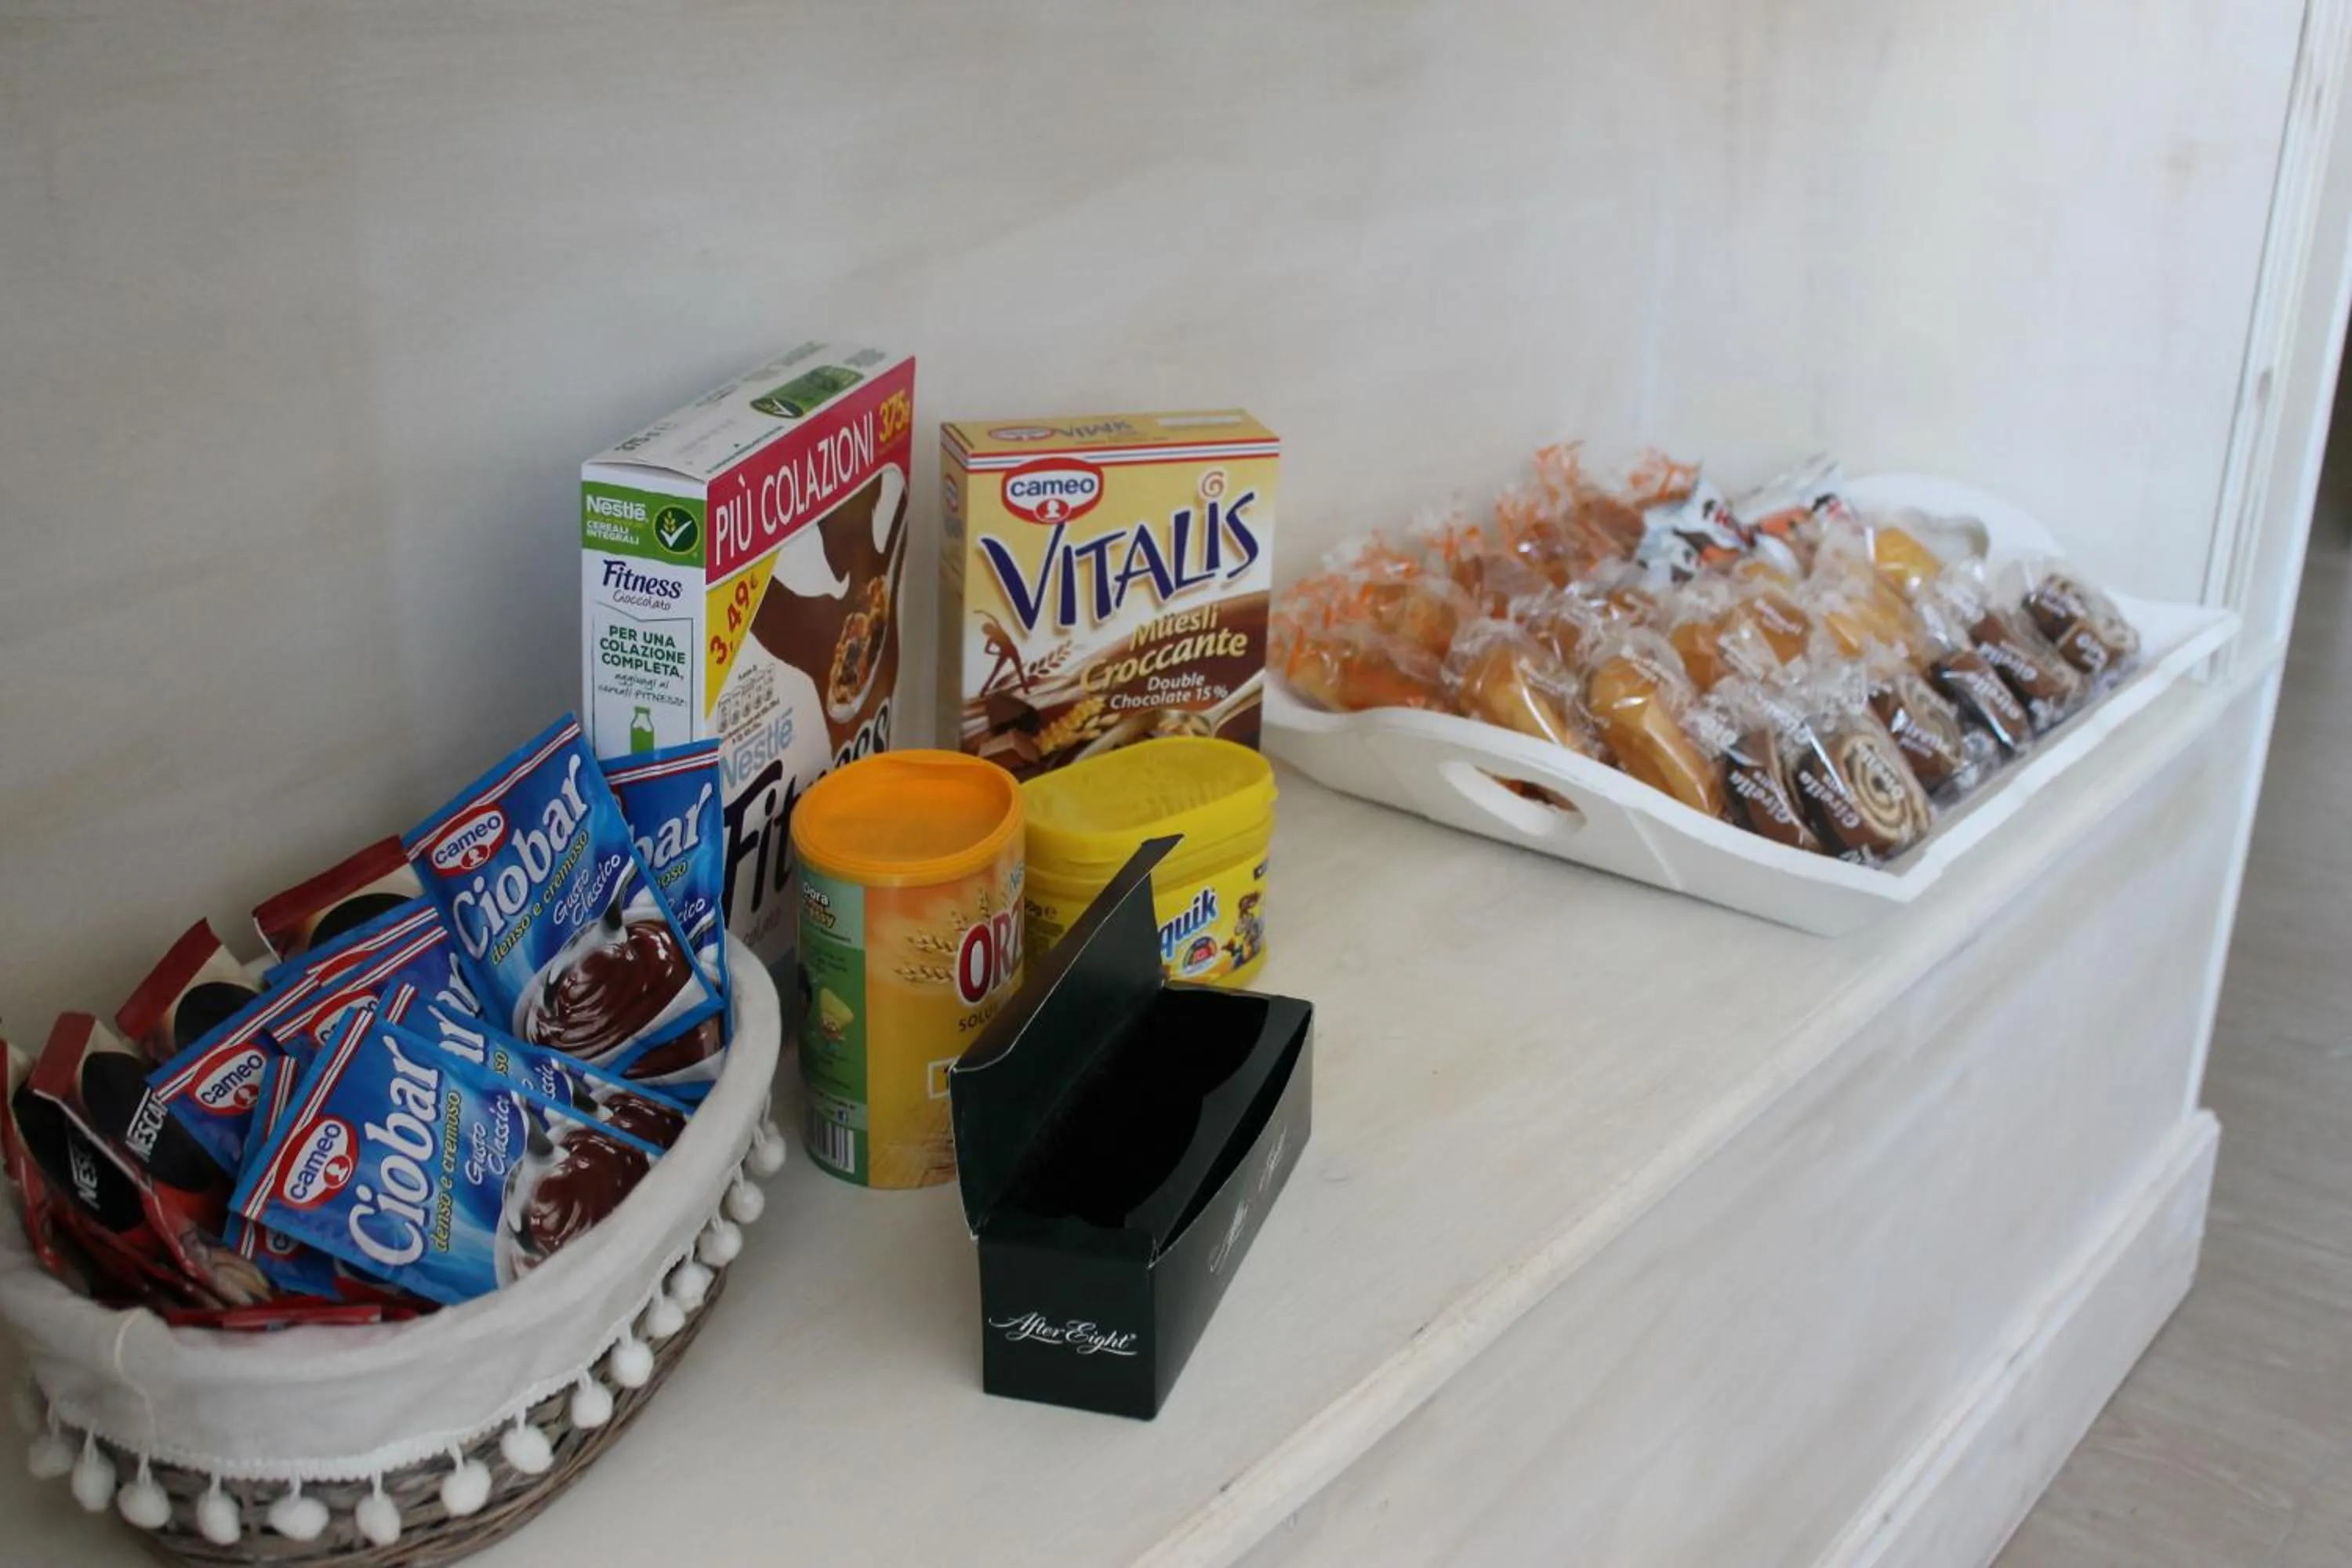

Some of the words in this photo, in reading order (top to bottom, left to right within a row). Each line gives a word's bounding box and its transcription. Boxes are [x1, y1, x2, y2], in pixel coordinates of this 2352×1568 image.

[716, 474, 753, 566] PIÙ
[760, 411, 873, 535] COLAZIONI
[1010, 477, 1095, 497] cameo
[602, 559, 682, 599] Fitness
[981, 474, 1259, 630] VITALIS
[612, 589, 672, 611] Cioccolato
[600, 637, 686, 665] COLAZIONE
[609, 625, 637, 641] PER
[643, 631, 676, 648] UNA
[1080, 629, 1248, 693] Croccante
[1110, 691, 1191, 709] Chocolate
[1147, 672, 1205, 691] Double
[719, 707, 795, 788] Nestlé
[434, 815, 501, 865] cameo
[452, 753, 589, 961] Ciobar
[490, 913, 532, 966] denso
[532, 902, 543, 916] e
[543, 829, 588, 903] cremoso
[553, 869, 590, 926] Gusto
[572, 854, 622, 927] Classico
[1160, 889, 1217, 959] quik
[200, 1054, 263, 1105] cameo
[289, 1123, 342, 1200] cameo
[350, 1035, 439, 1266] Ciobar
[443, 1090, 462, 1174] cremoso
[465, 1122, 488, 1185] Gusto
[445, 1175, 454, 1189] e
[431, 1192, 453, 1253] denso
[989, 1311, 1065, 1345] After
[1065, 1320, 1138, 1356] Eight
